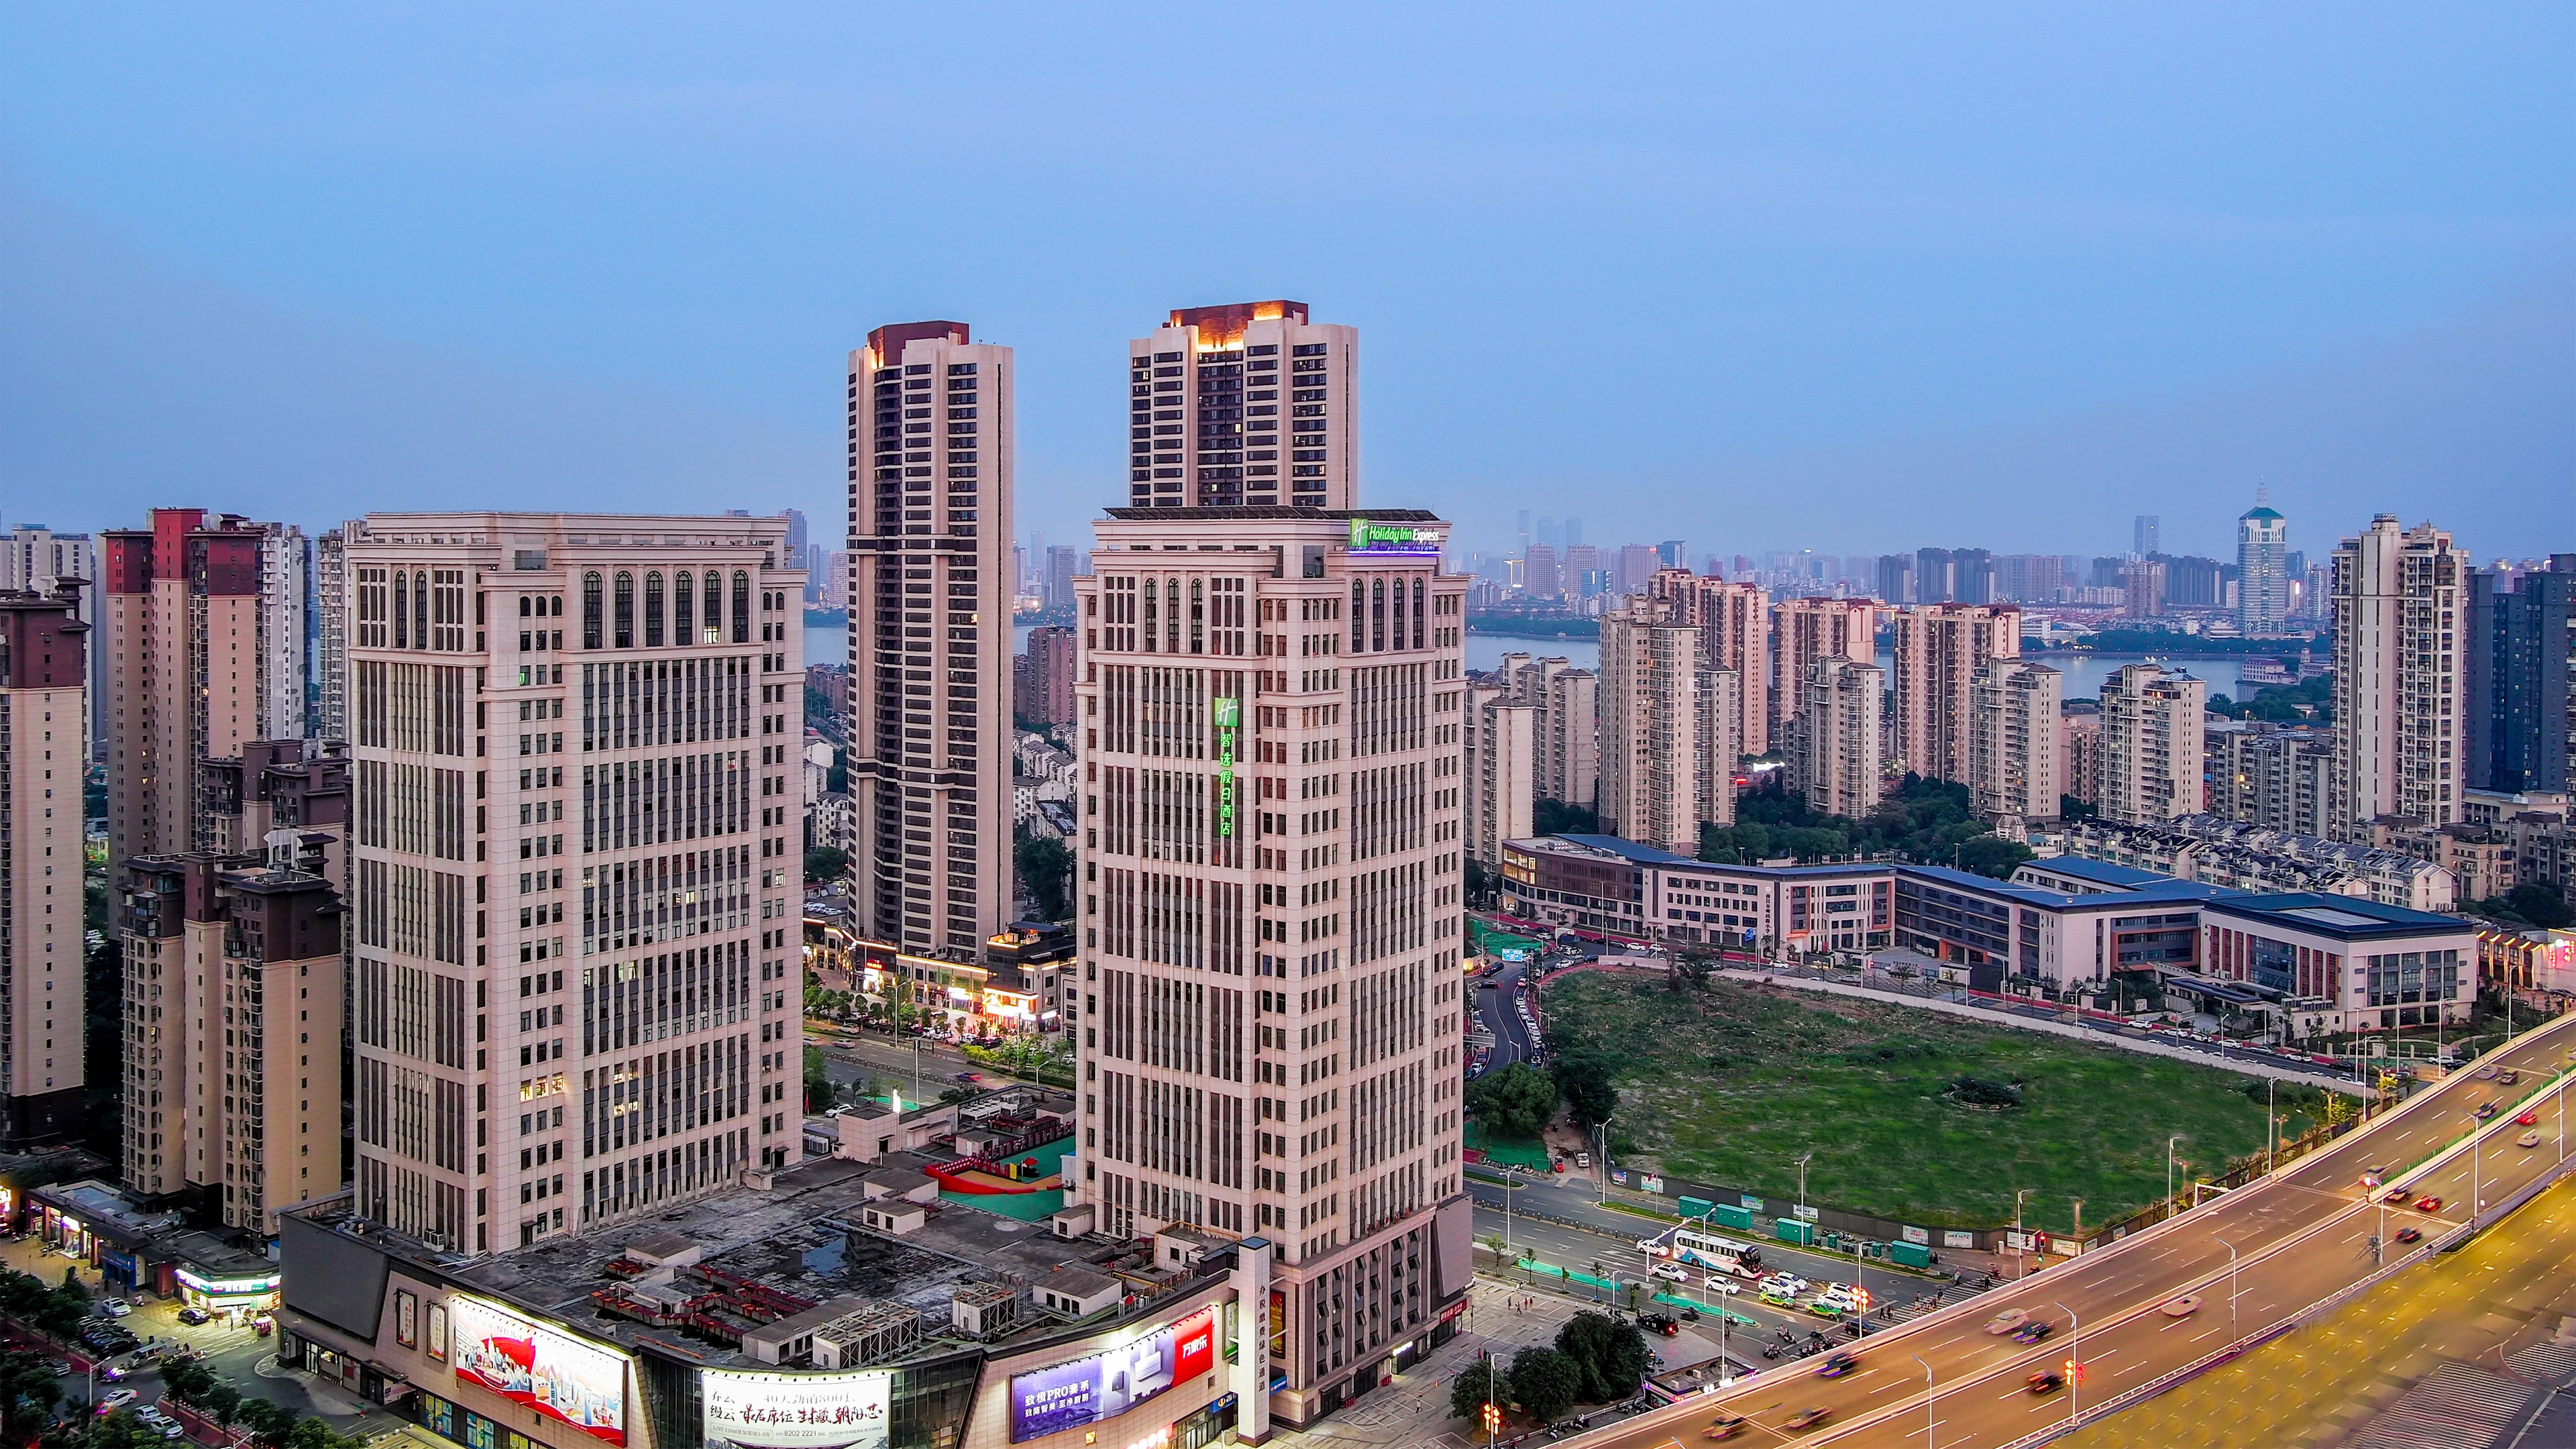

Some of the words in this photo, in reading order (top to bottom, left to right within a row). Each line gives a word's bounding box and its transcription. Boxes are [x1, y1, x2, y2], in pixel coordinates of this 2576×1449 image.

[1369, 525, 1399, 543] Holiday
[1400, 526, 1412, 540] Inn
[1412, 529, 1439, 543] Express
[1220, 732, 1232, 835] 智选假日酒店
[1182, 1334, 1207, 1358] 万家乐
[1024, 1379, 1089, 1407] 致极PRO套系
[740, 1403, 794, 1428] 最后席位
[1025, 1402, 1056, 1417] 致简智美
